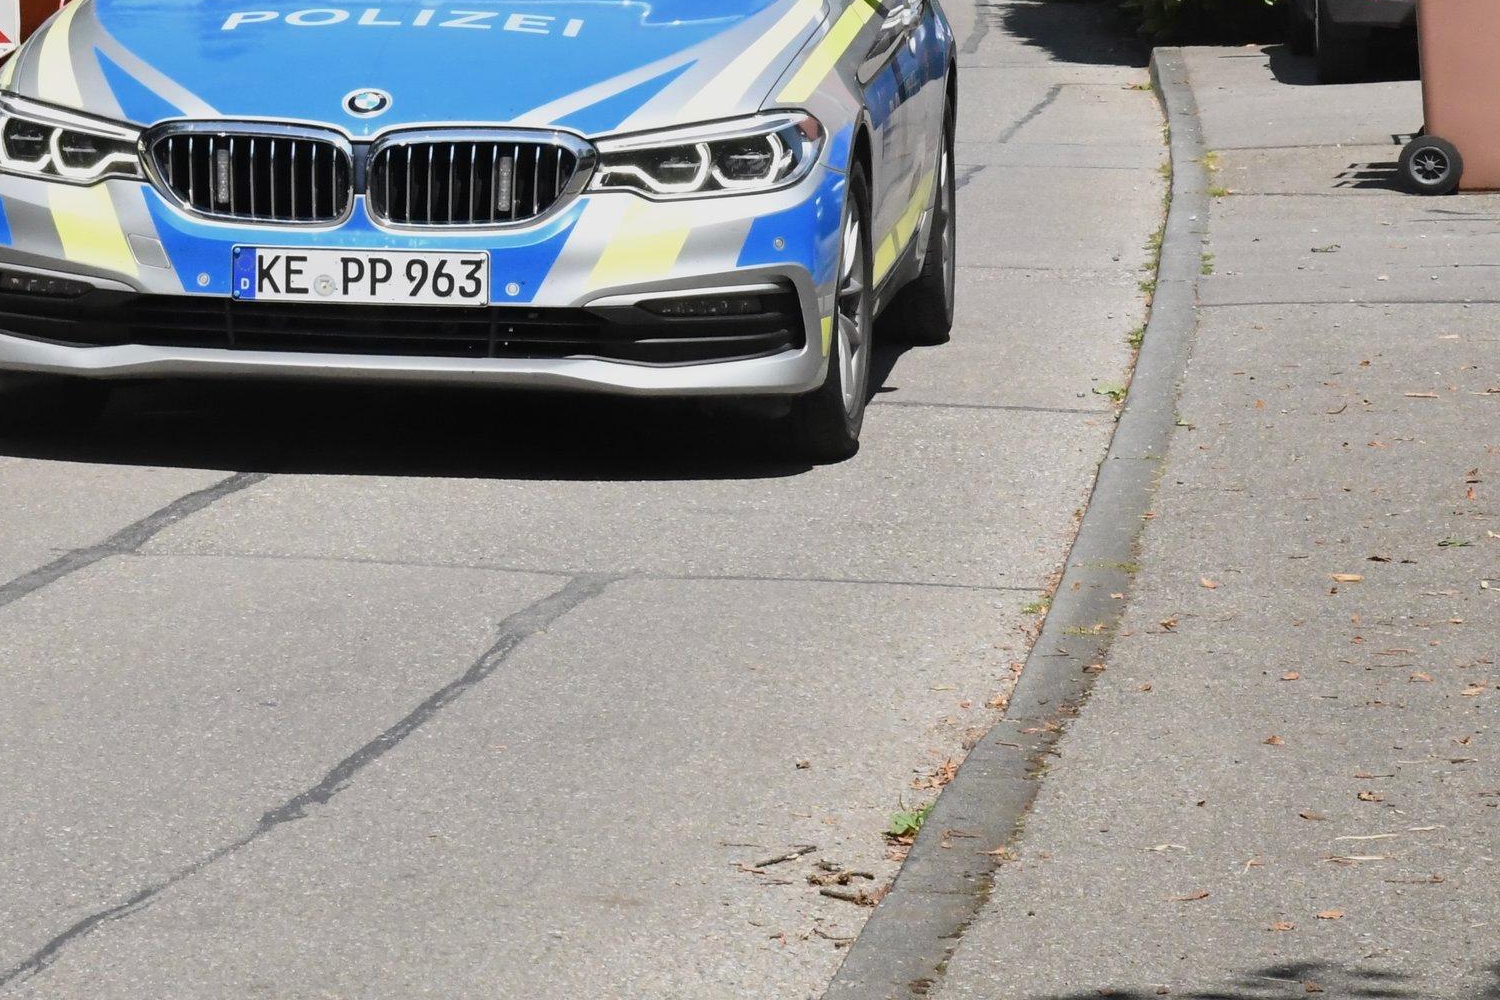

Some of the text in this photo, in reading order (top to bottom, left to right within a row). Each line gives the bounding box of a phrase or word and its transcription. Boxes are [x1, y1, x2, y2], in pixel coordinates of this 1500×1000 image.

[221, 8, 584, 38] POLIZEI
[240, 277, 250, 290] D
[257, 255, 483, 298] KE PP 963
